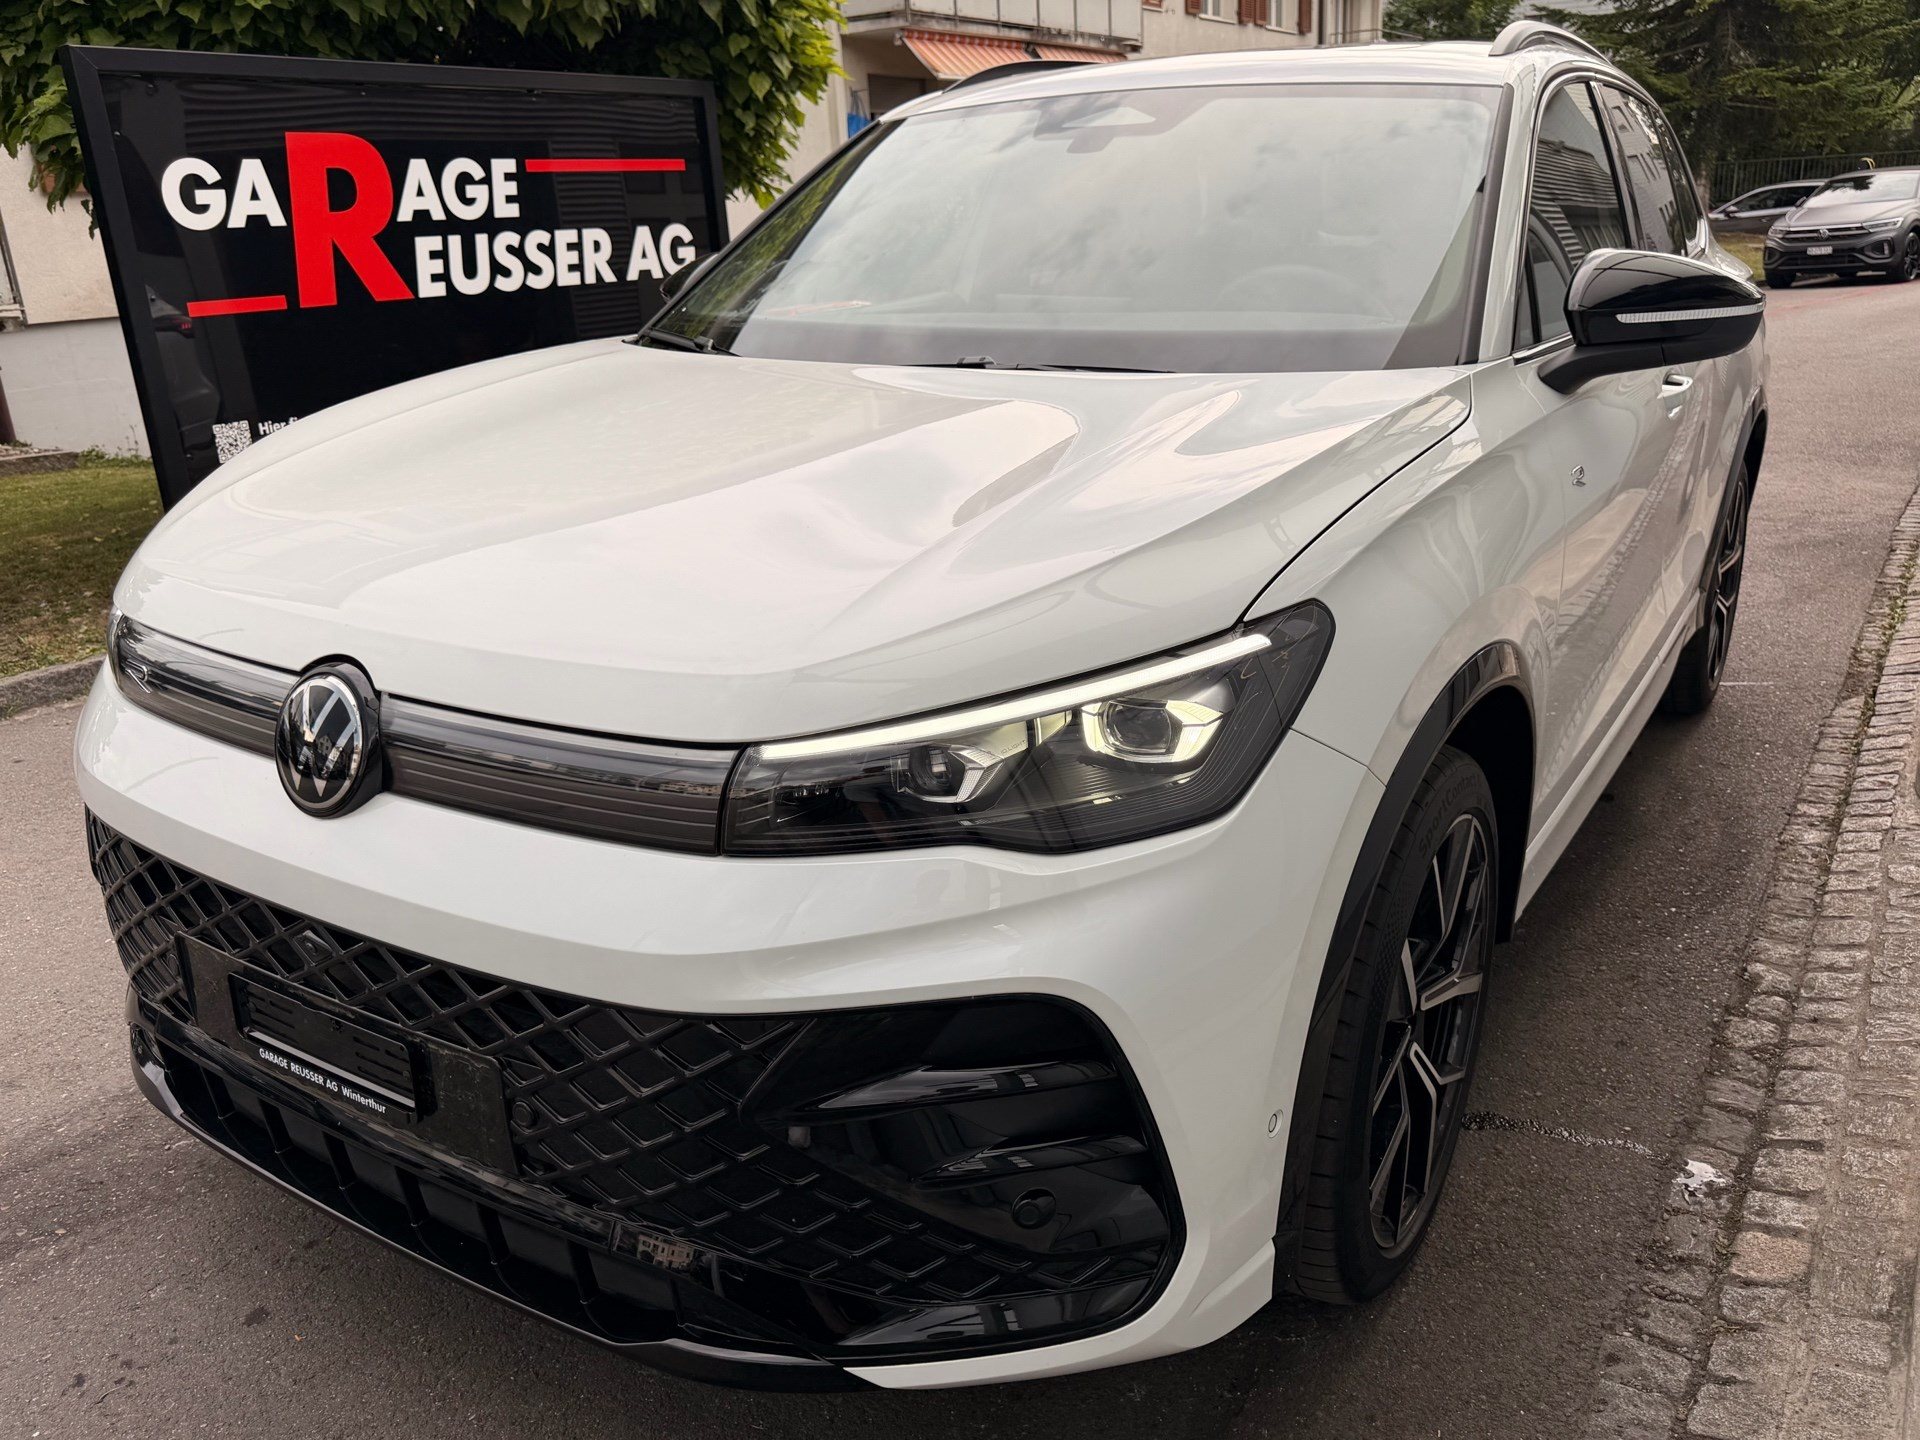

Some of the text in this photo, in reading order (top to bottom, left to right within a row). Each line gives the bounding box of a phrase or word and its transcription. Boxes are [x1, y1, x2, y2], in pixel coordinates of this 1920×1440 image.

[161, 131, 520, 308] GARAGE
[627, 223, 696, 281] AG
[259, 1048, 386, 1114] GARAGE REUSSER AG Winterthur
